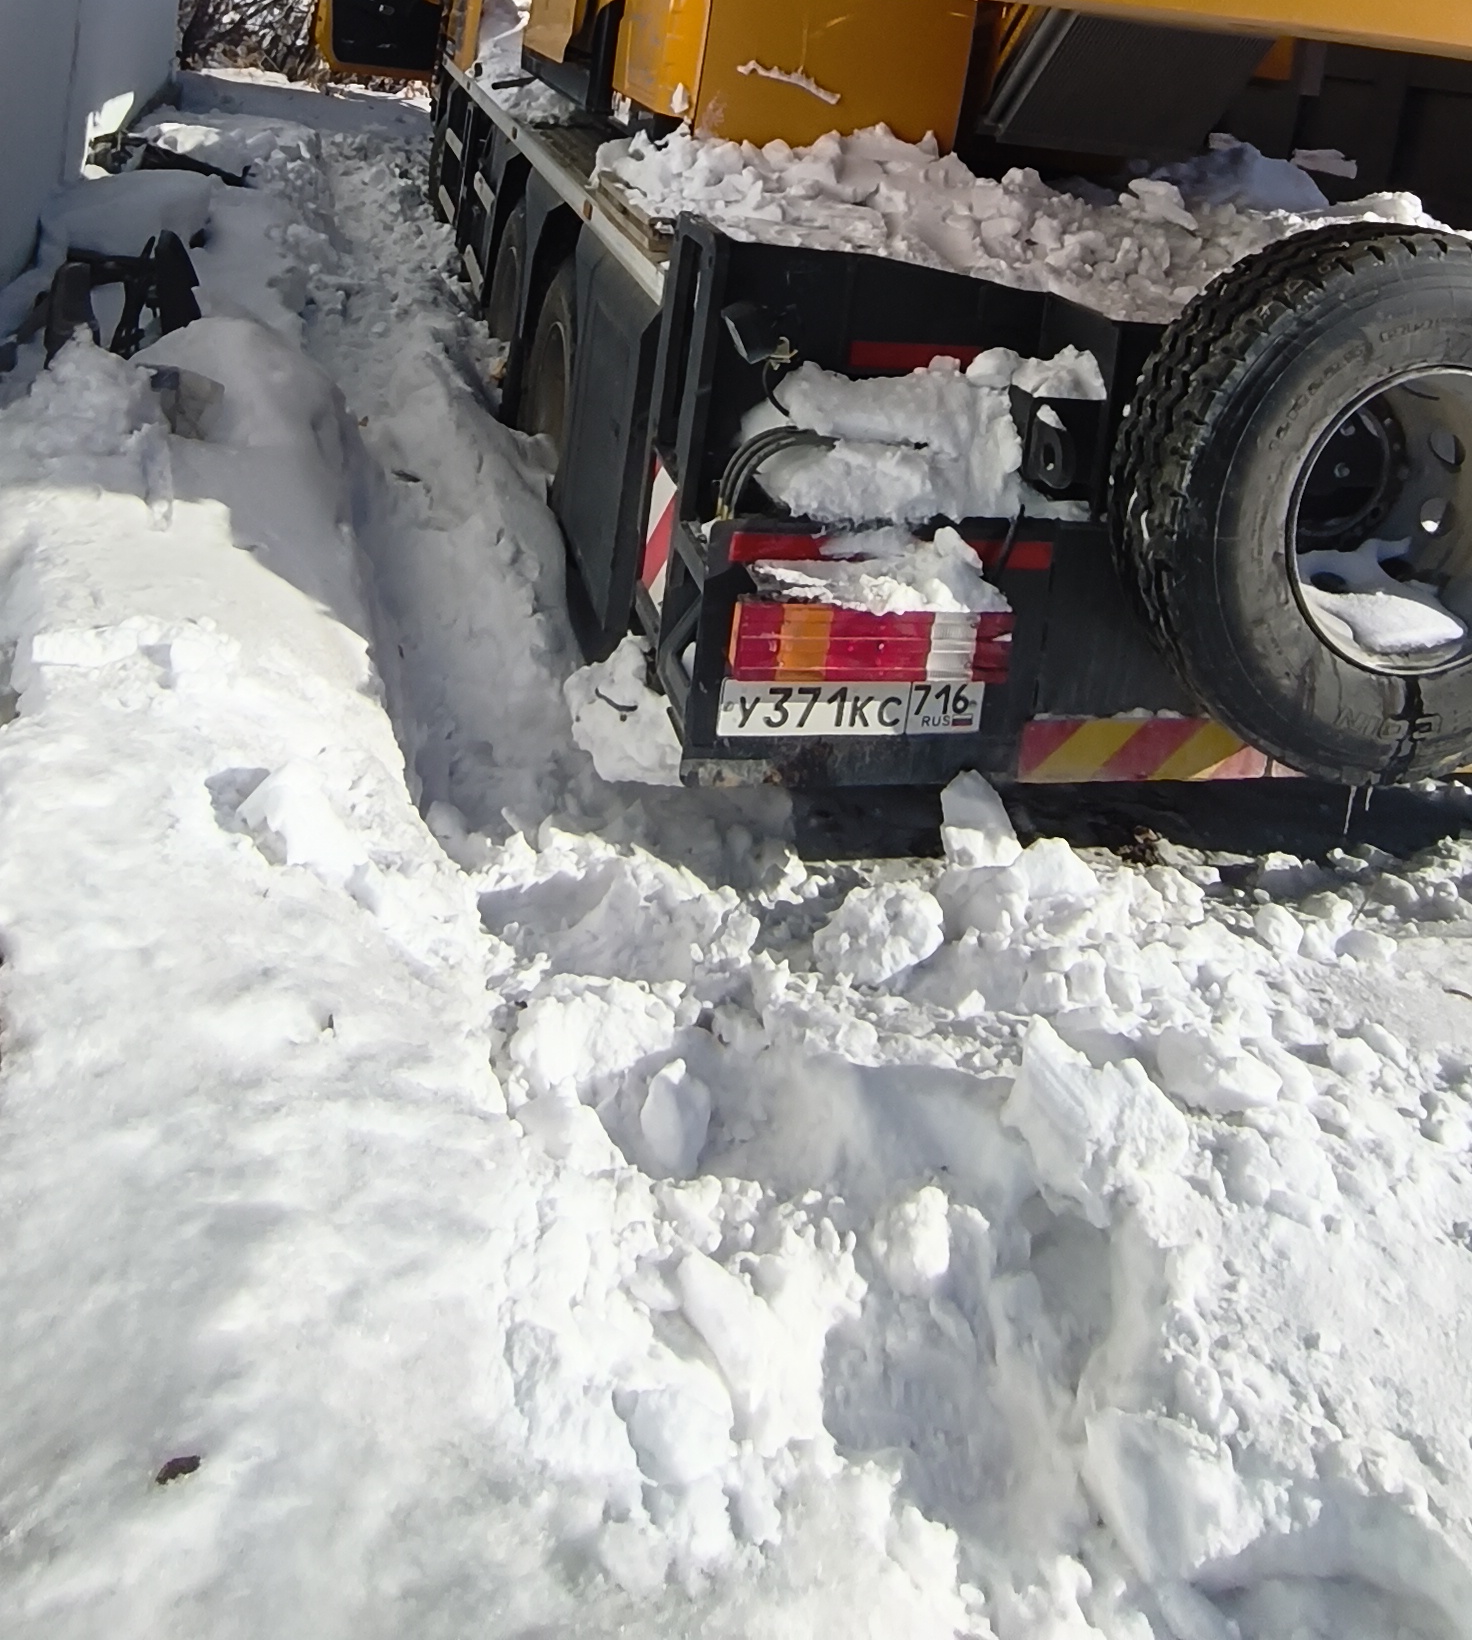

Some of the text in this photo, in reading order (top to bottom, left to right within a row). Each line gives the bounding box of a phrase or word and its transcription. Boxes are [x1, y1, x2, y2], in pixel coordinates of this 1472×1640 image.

[738, 683, 970, 728] У371КС 716
[921, 715, 951, 727] RUS
